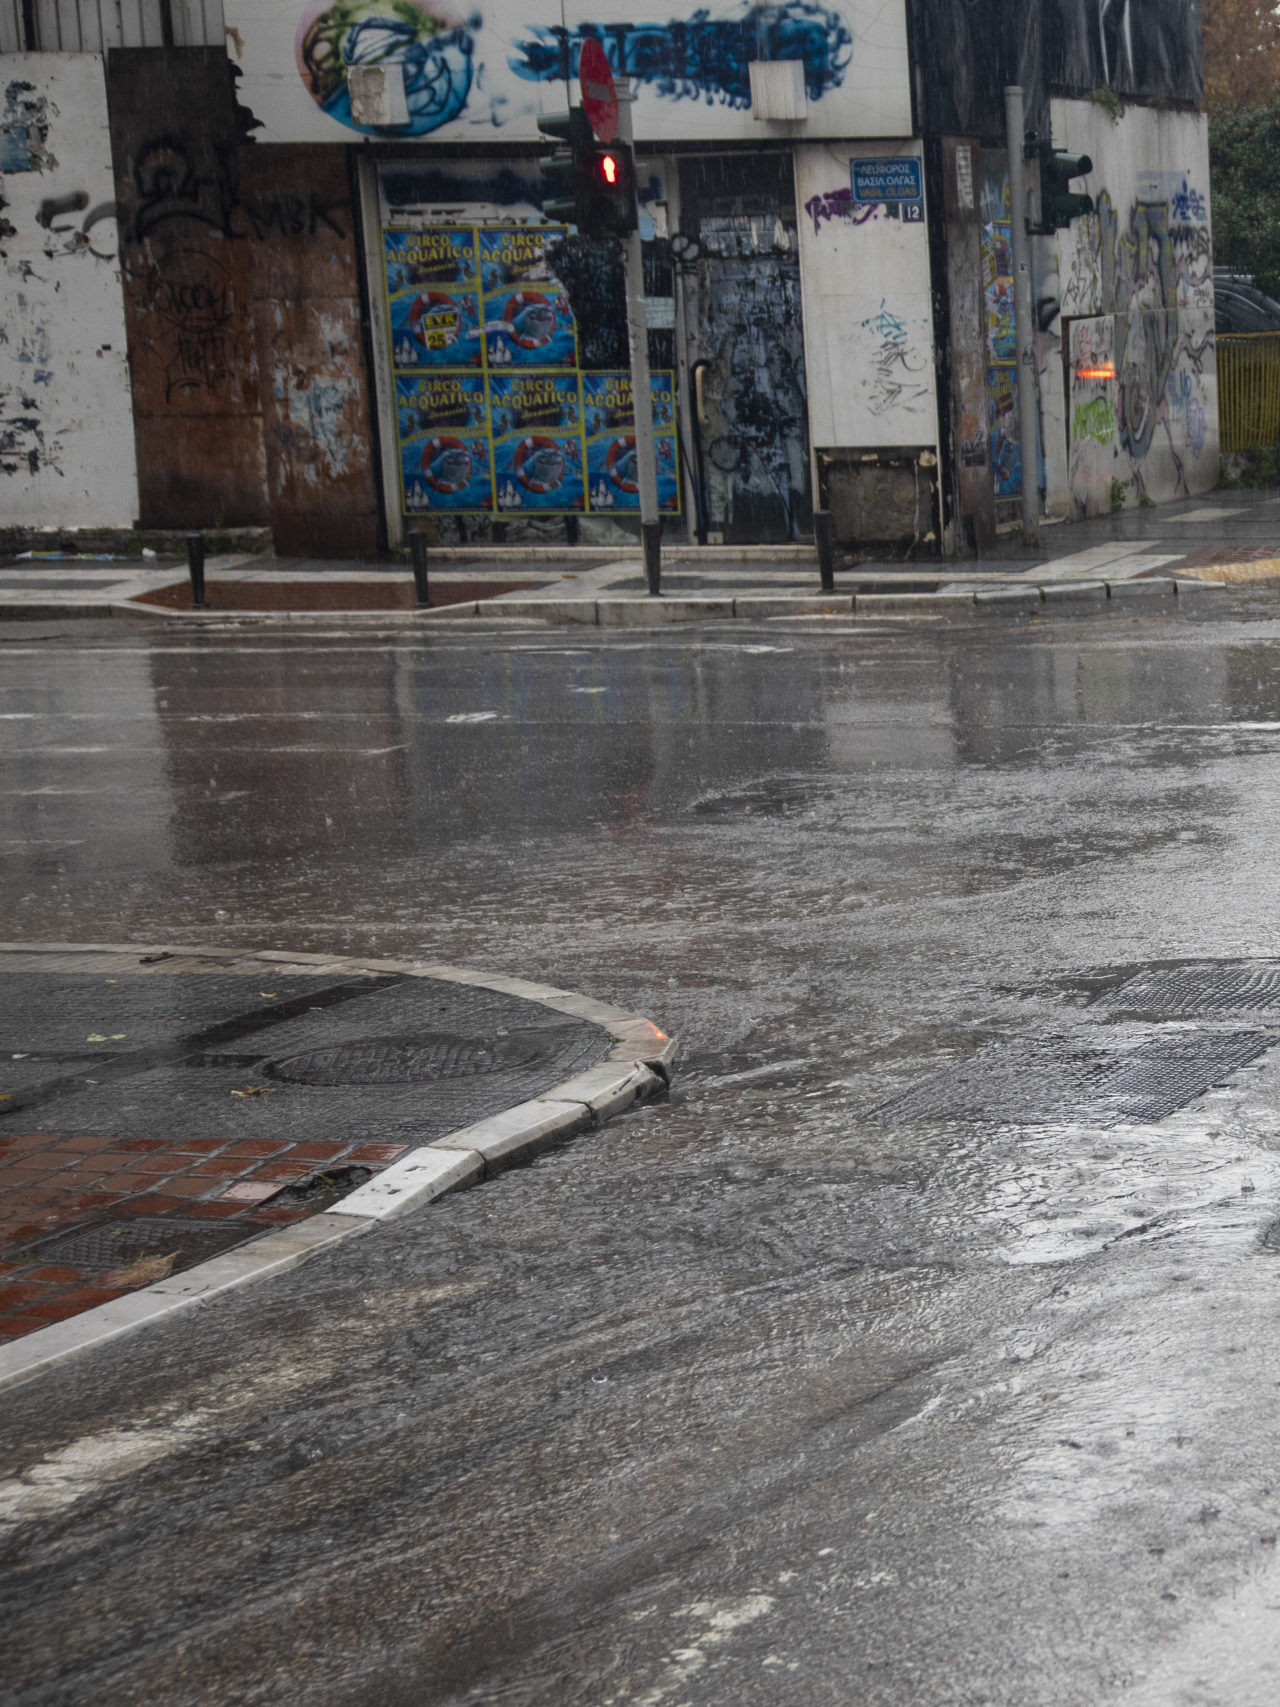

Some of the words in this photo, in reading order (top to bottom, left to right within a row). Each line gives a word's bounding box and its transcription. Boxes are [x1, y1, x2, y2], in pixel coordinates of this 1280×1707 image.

[886, 176, 916, 185] ΟΛΓΑΣ
[907, 206, 920, 219] 12
[407, 234, 451, 248] CIRCO
[501, 234, 545, 248] CIRCO
[387, 246, 474, 265] ACQUATICO
[481, 248, 541, 265] ACQUA
[418, 379, 461, 392] CIRCO
[511, 379, 555, 392] CIRCO
[398, 390, 484, 409] ACQUATICO
[492, 390, 578, 408] ACQUATICO
[585, 390, 671, 408] ACQUACO
